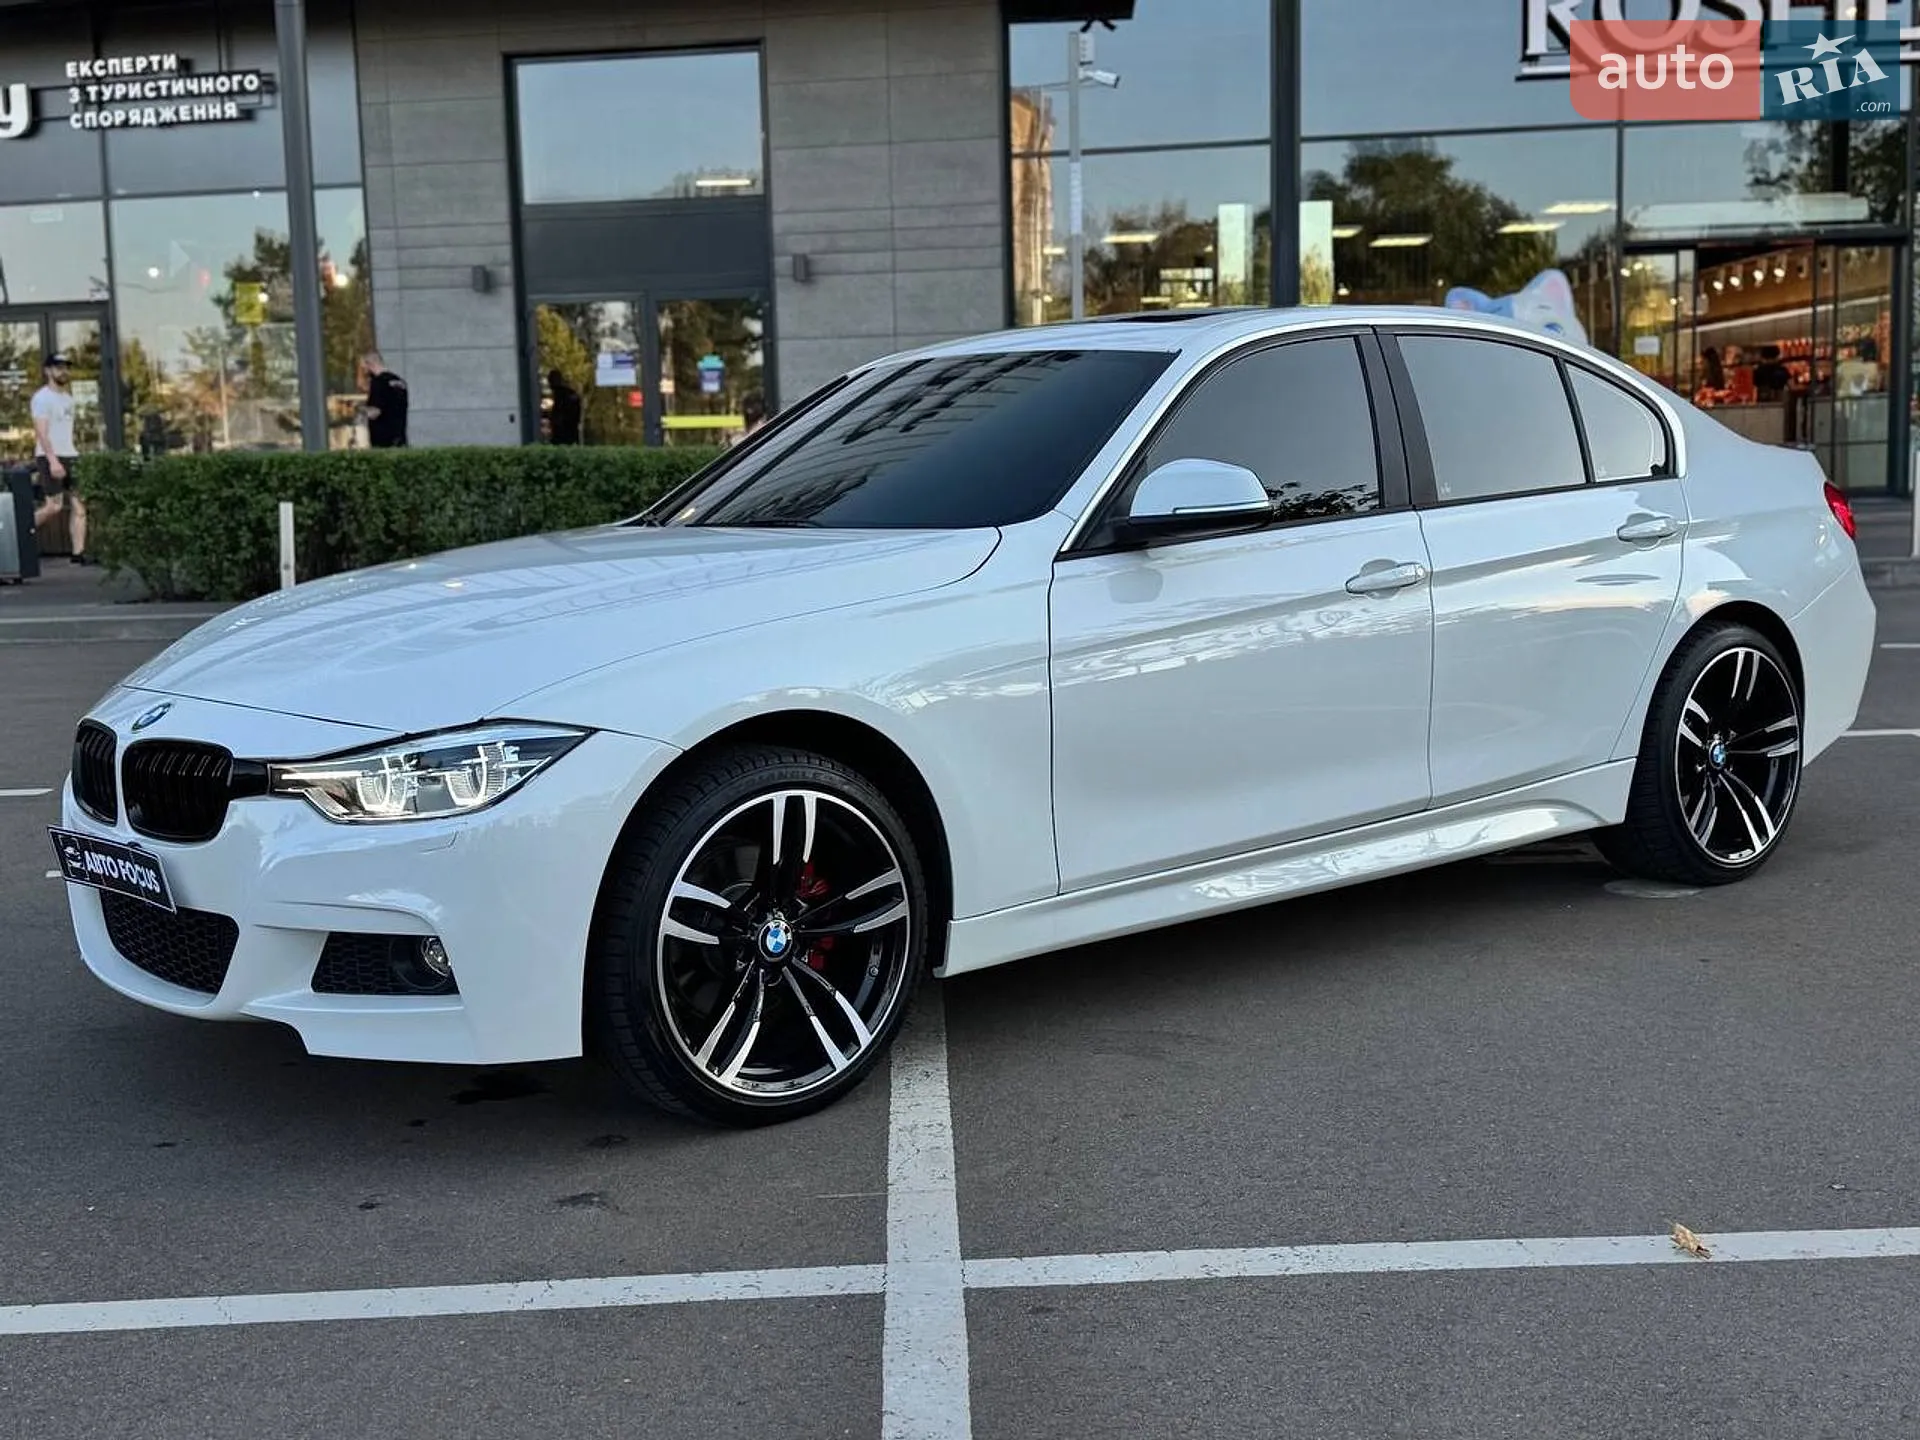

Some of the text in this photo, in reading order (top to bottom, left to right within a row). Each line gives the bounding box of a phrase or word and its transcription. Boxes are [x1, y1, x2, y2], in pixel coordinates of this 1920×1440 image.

[65, 54, 178, 78] ЕКСПЕРТИ
[86, 73, 260, 102] ТУРИСТИЧНОГО
[69, 101, 239, 129] СПОРЯДЖЕННЯ
[117, 858, 161, 894] FOCUS
